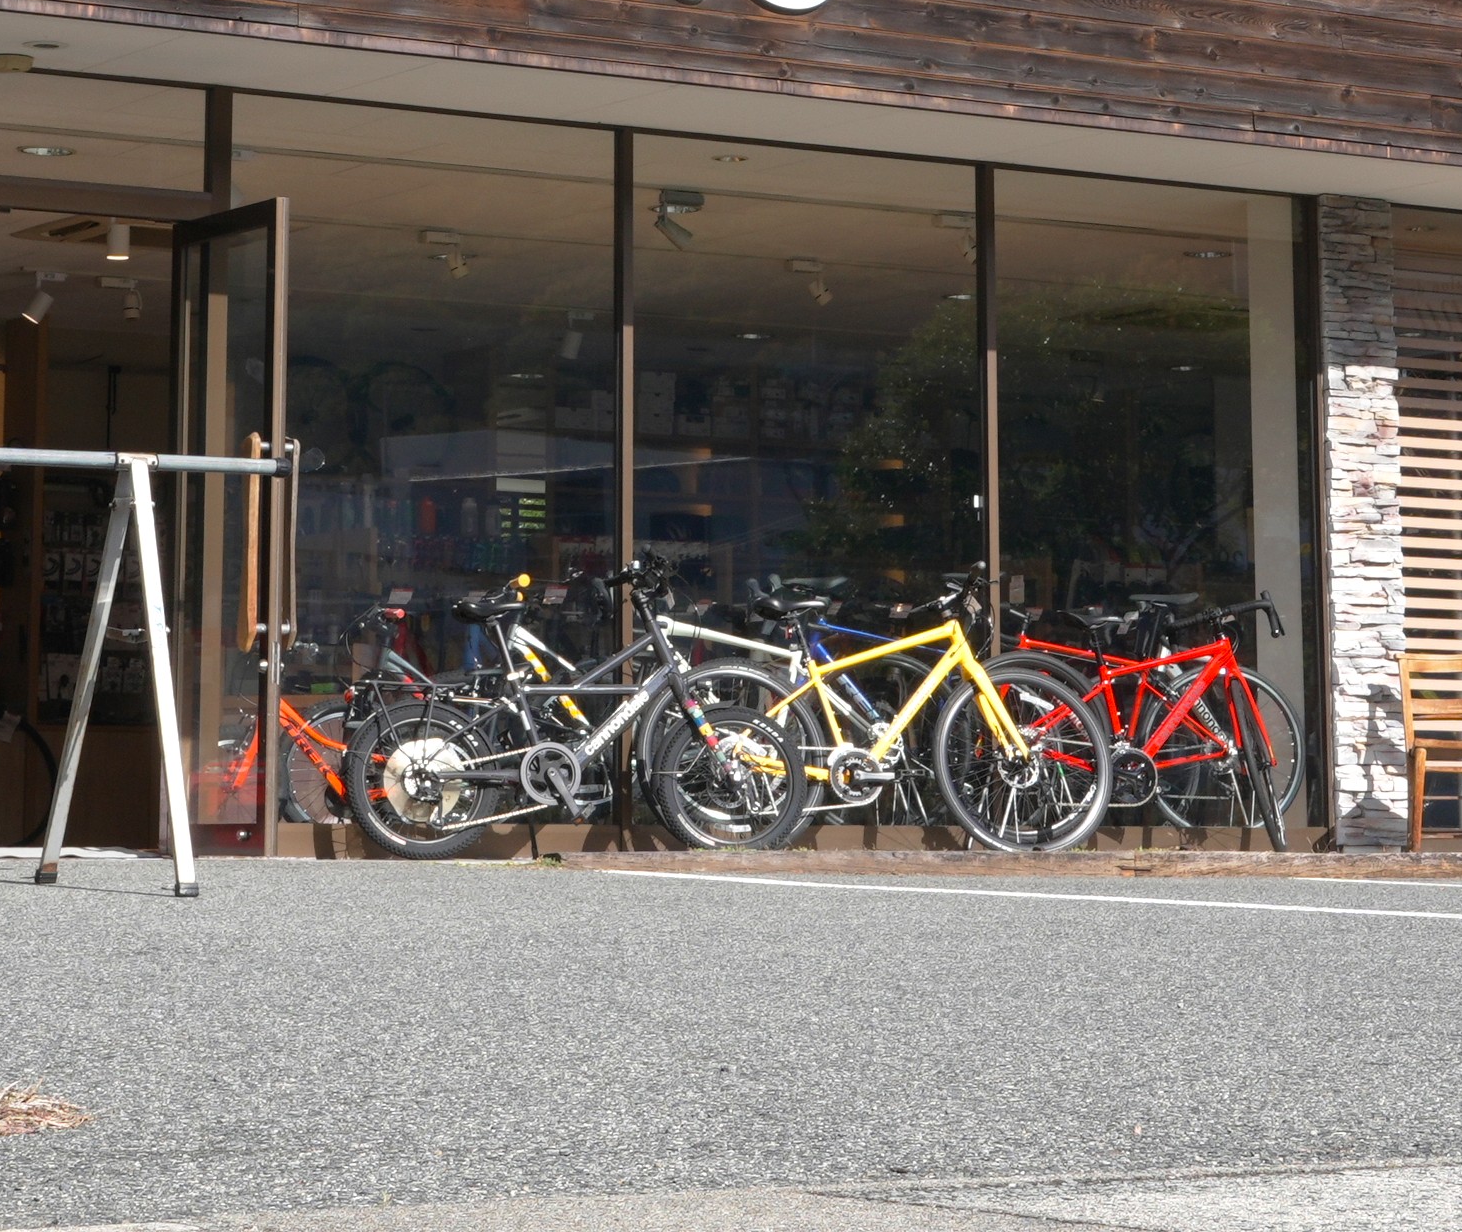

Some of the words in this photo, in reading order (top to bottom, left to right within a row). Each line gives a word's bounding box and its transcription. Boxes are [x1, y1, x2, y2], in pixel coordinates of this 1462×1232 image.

[283, 722, 333, 777] TREK
[584, 690, 650, 756] cannondale
[752, 718, 784, 743] KENDA
